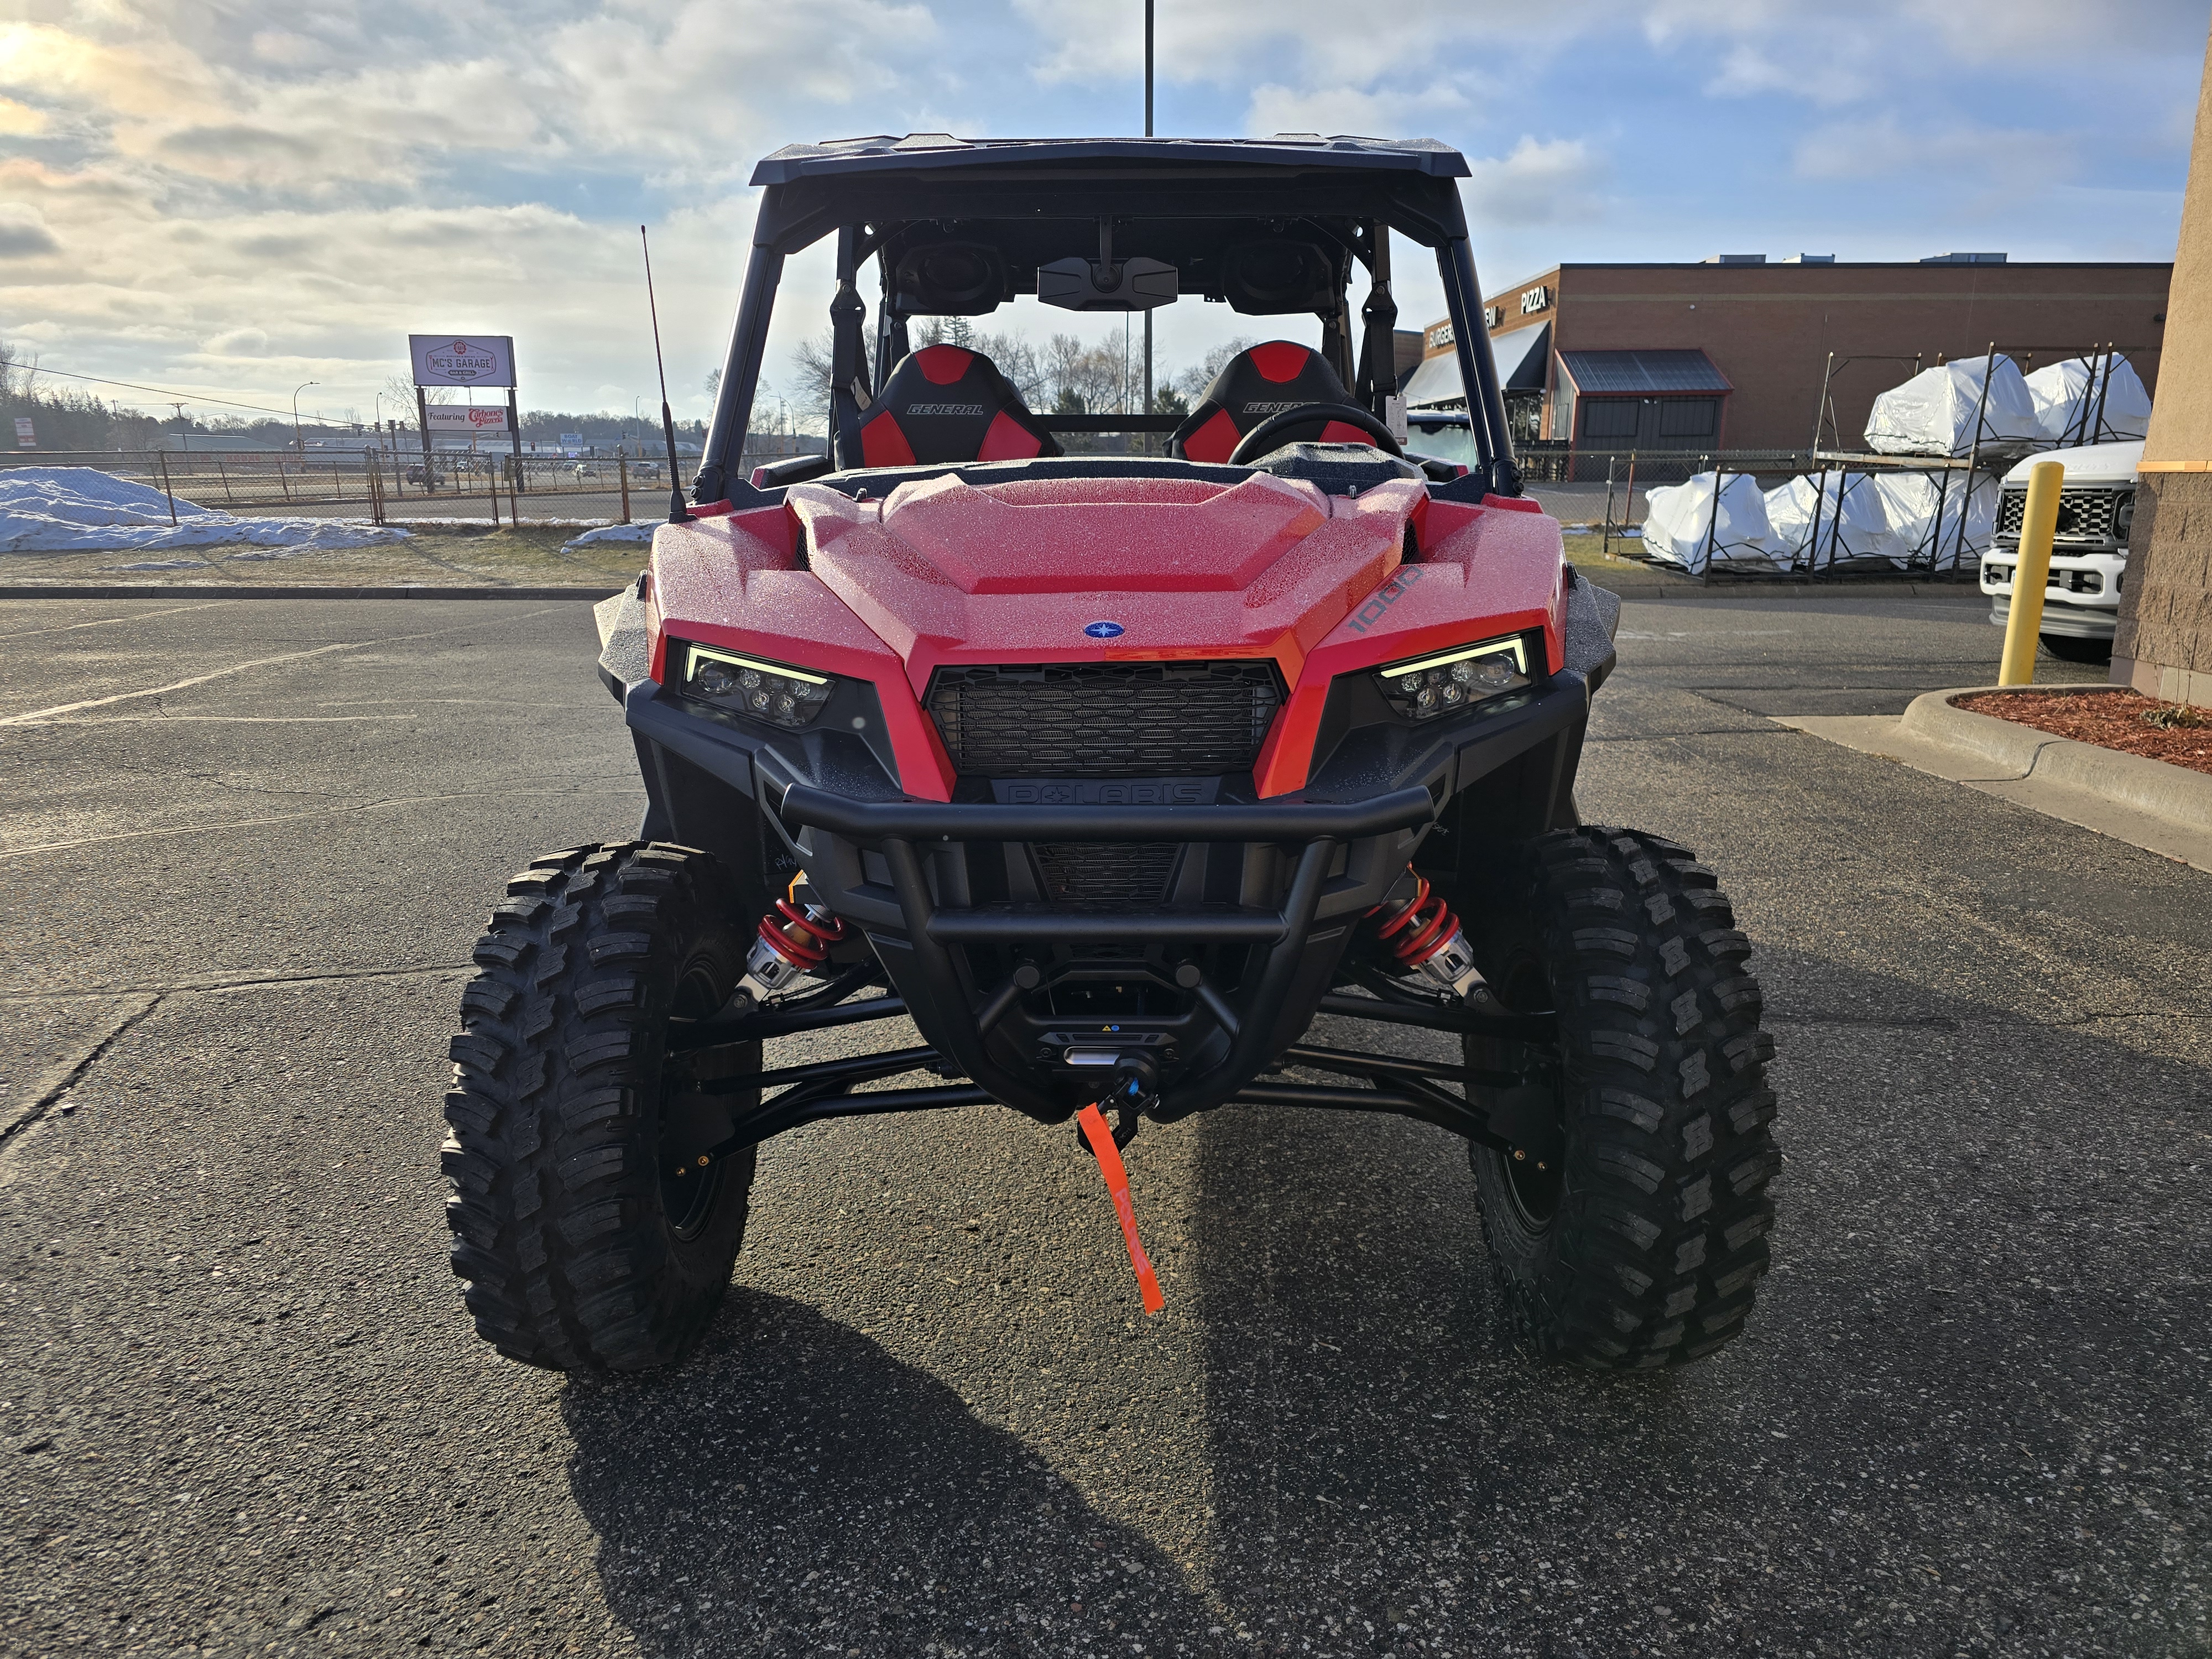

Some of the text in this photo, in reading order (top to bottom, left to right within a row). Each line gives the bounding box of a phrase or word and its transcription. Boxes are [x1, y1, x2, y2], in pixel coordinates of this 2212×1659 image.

[1429, 324, 1454, 348] BURGER
[1521, 285, 1546, 315] PIZZA
[432, 358, 491, 368] MC'S GARAGE
[428, 408, 503, 422] Featuring Carbone's
[907, 404, 983, 415] GENERAL
[1348, 565, 1425, 634] 1000
[1008, 784, 1202, 804] POLARIS
[1115, 1187, 1150, 1275] POLARIS
